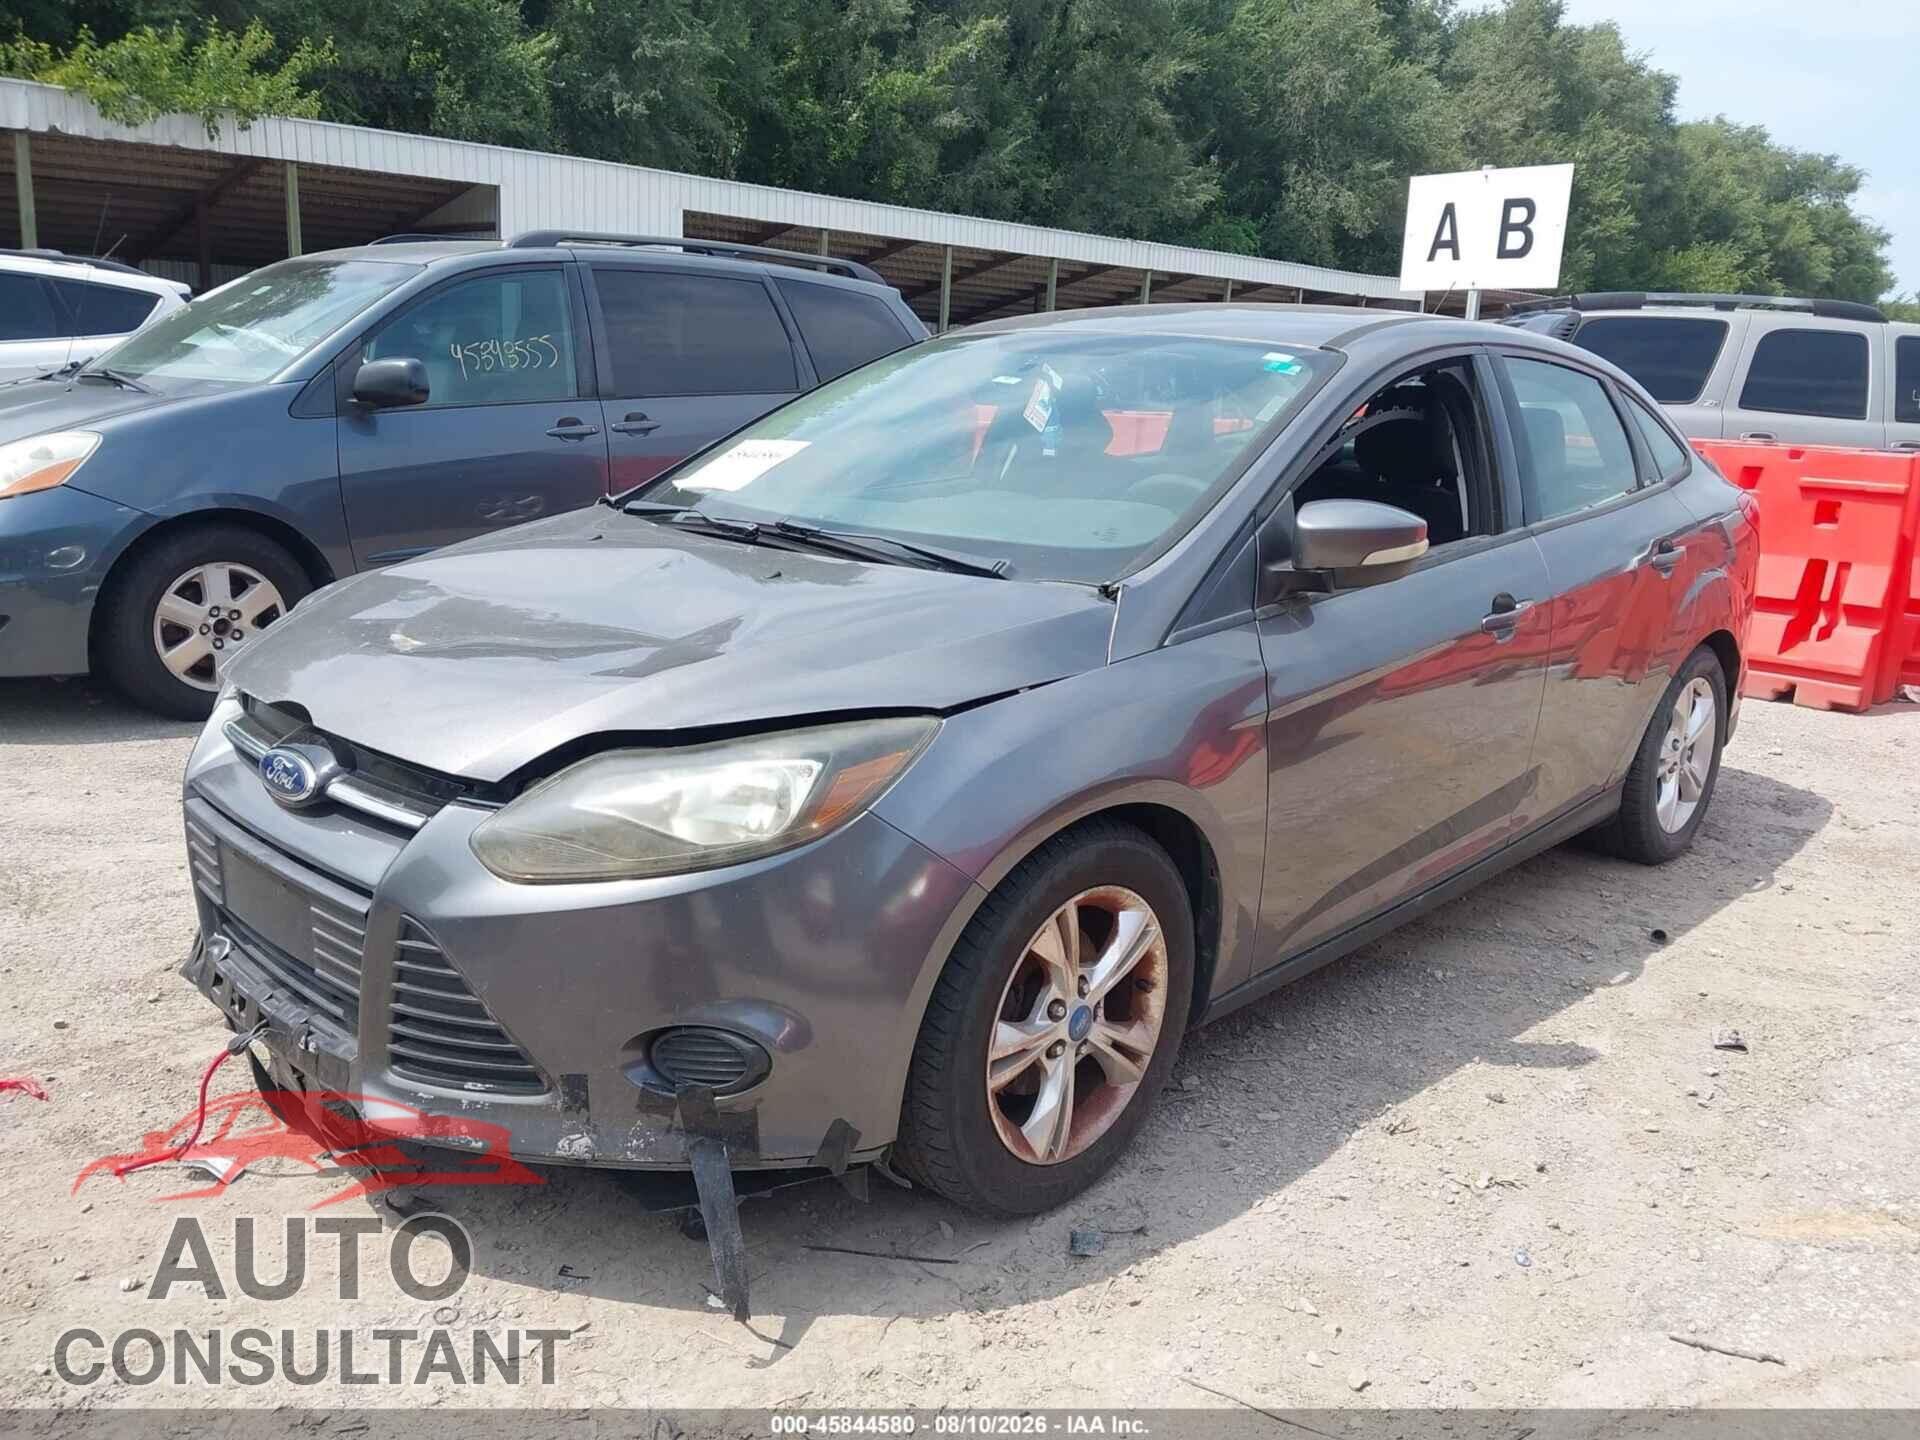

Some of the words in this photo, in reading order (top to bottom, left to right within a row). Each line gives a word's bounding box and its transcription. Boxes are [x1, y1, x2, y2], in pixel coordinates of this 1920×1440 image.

[1426, 202, 1461, 262] A
[1496, 197, 1537, 260] B
[266, 756, 299, 790] Ford
